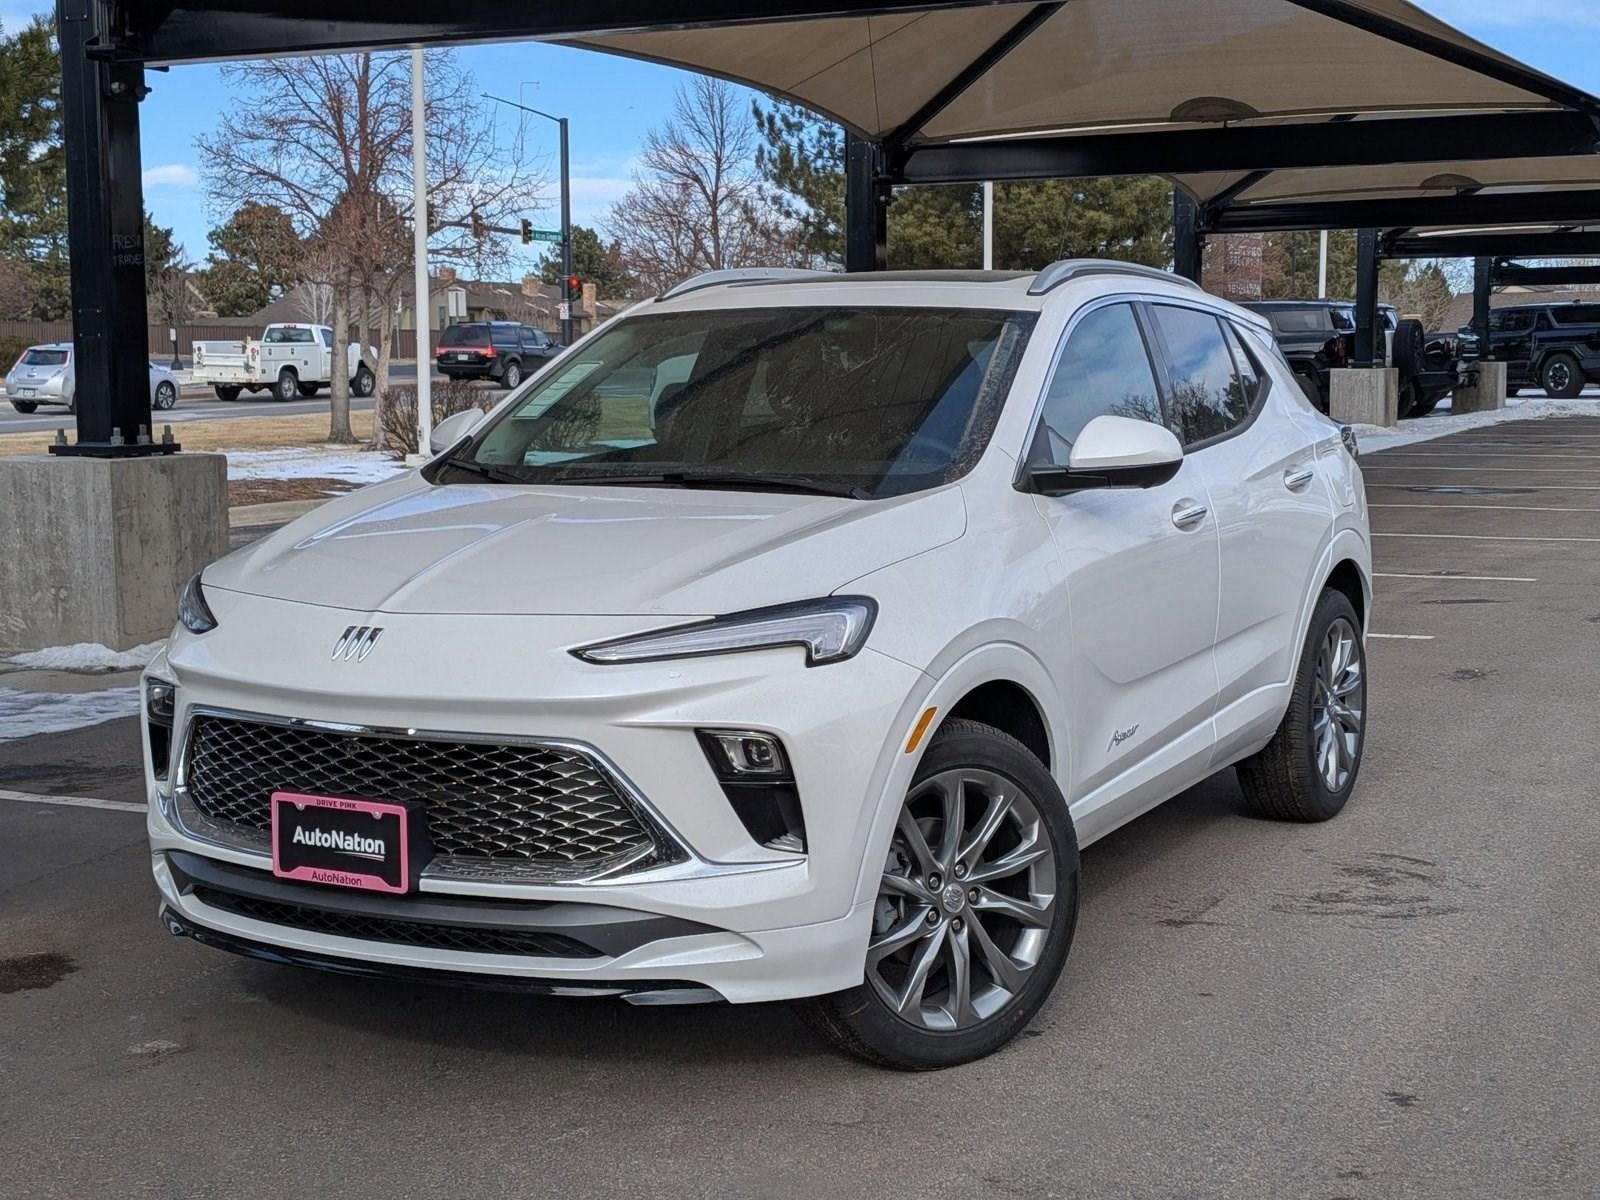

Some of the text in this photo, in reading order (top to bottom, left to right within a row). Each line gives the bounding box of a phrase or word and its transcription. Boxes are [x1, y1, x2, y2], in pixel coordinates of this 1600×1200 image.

[316, 799, 338, 808] DRIVE
[292, 825, 386, 854] AutoNation
[311, 872, 362, 886] AutoNation
